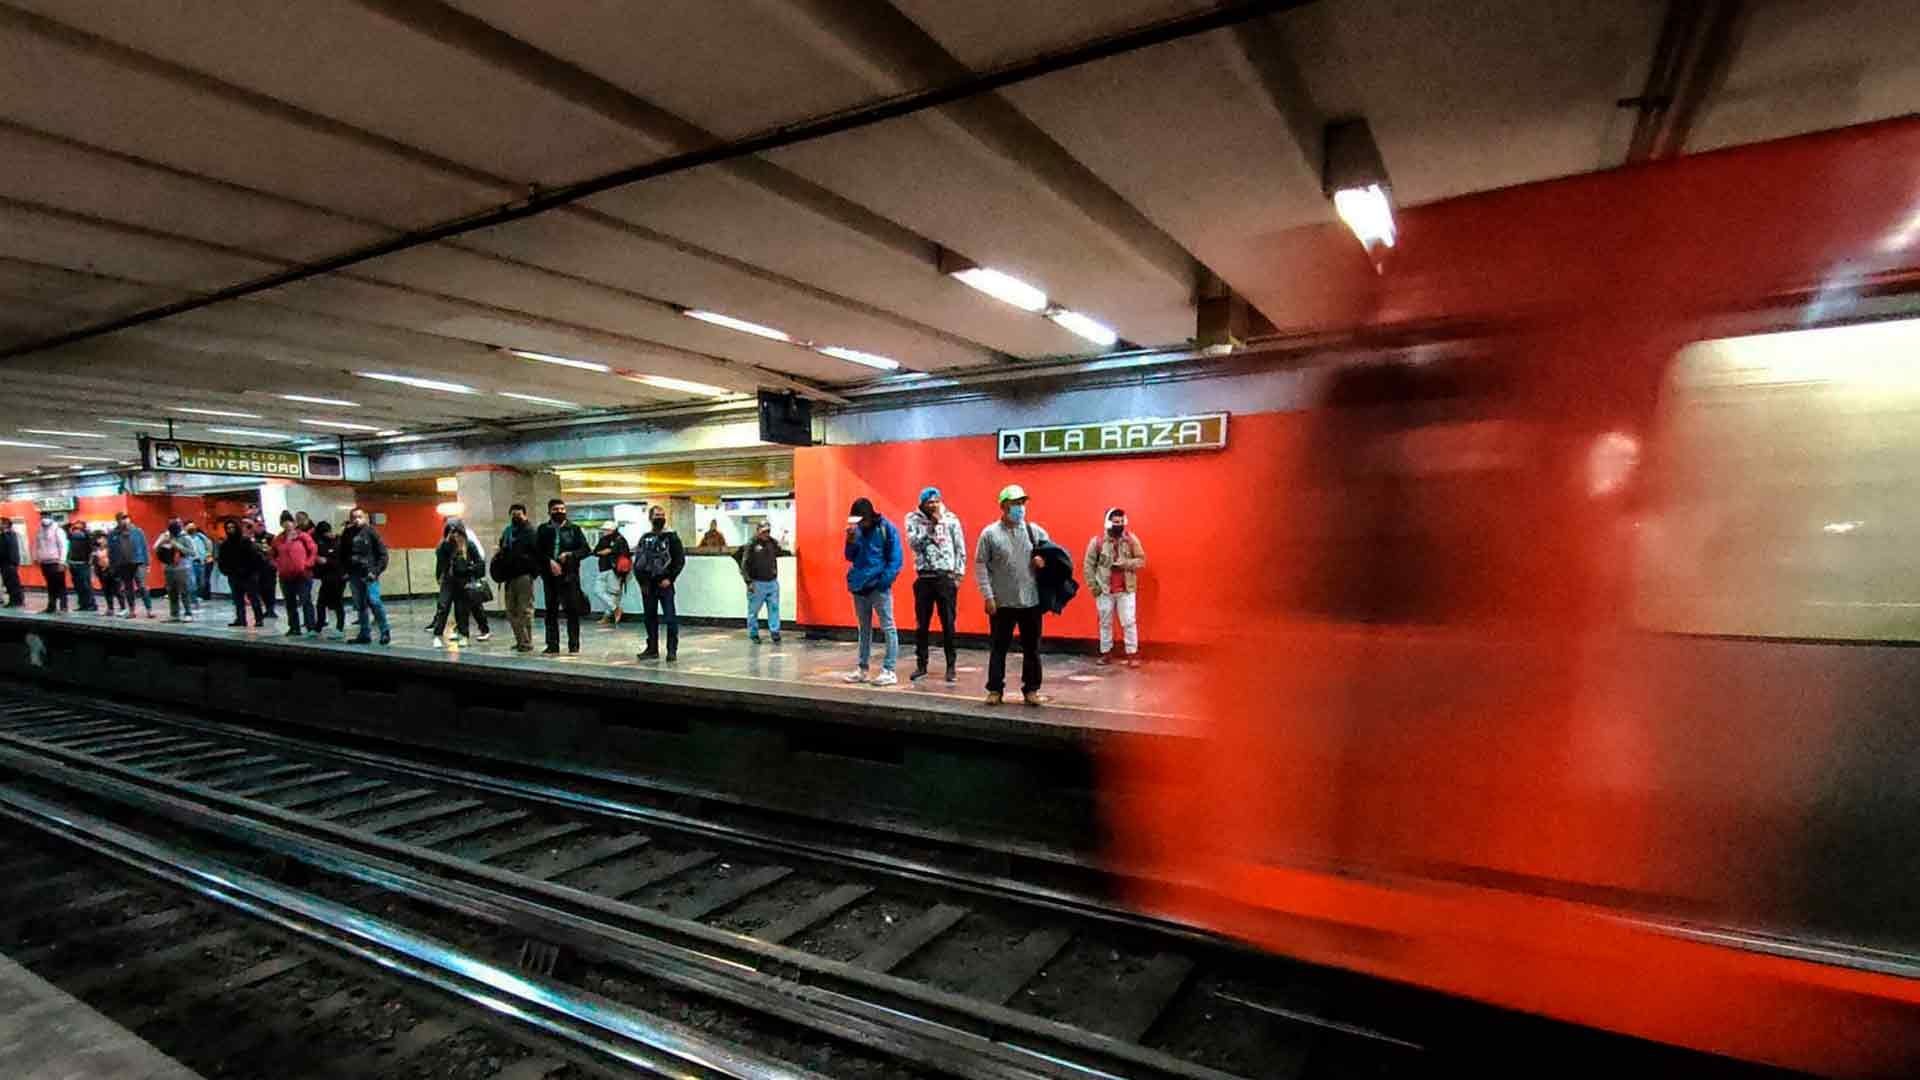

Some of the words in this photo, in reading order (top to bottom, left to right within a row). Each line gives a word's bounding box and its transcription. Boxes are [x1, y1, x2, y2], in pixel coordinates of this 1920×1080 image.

[1040, 429, 1084, 452] LA
[1101, 421, 1201, 448] RAZA
[184, 456, 299, 474] UNIVERSIDAD
